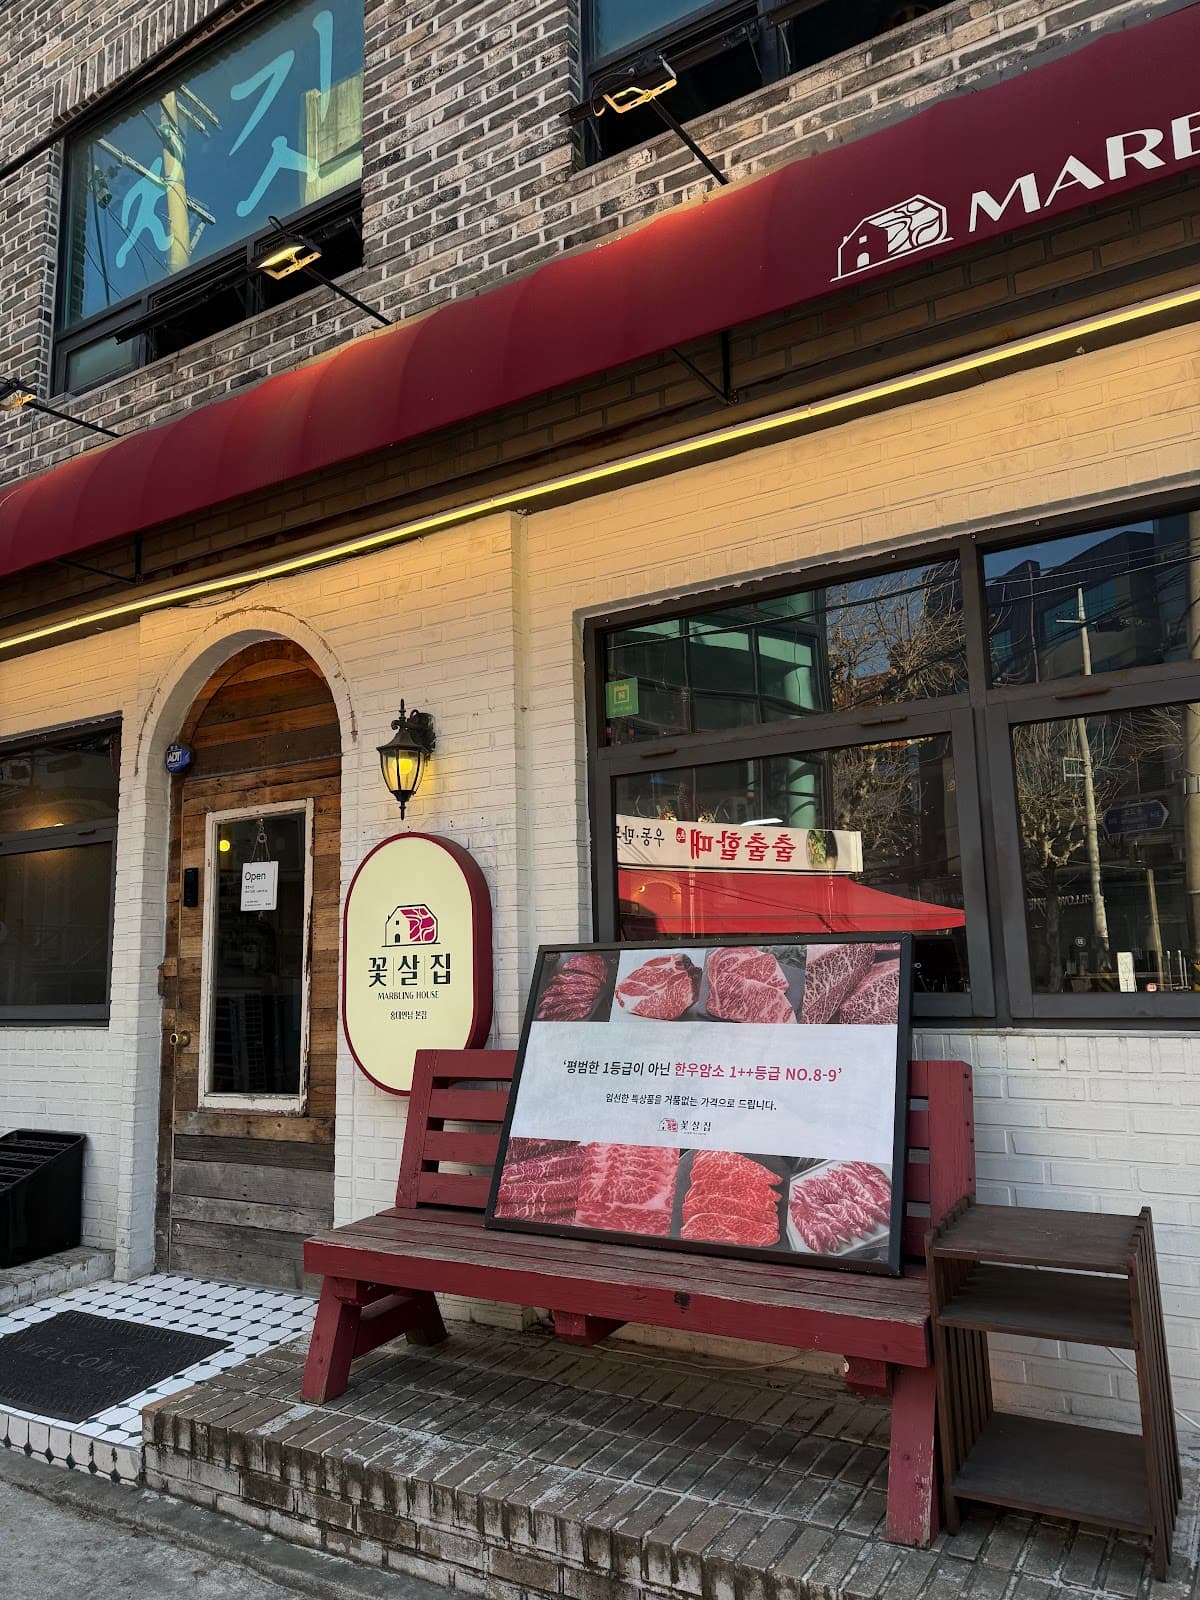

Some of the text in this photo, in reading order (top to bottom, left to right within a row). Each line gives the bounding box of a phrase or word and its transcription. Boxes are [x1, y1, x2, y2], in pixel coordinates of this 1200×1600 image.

[167, 751, 182, 764] ADT
[245, 871, 266, 883] Open
[378, 990, 439, 1000] MARBLING HOUSE
[602, 1061, 645, 1076] 1등급이
[648, 1062, 671, 1076] 아닌
[675, 1062, 725, 1078] 한우암소
[729, 1065, 781, 1081] 1++등급
[631, 1094, 662, 1105] 특상품을
[664, 1095, 698, 1107] 거품없는
[700, 1097, 735, 1108] 가격으로
[738, 1099, 777, 1111] 드립니다.
